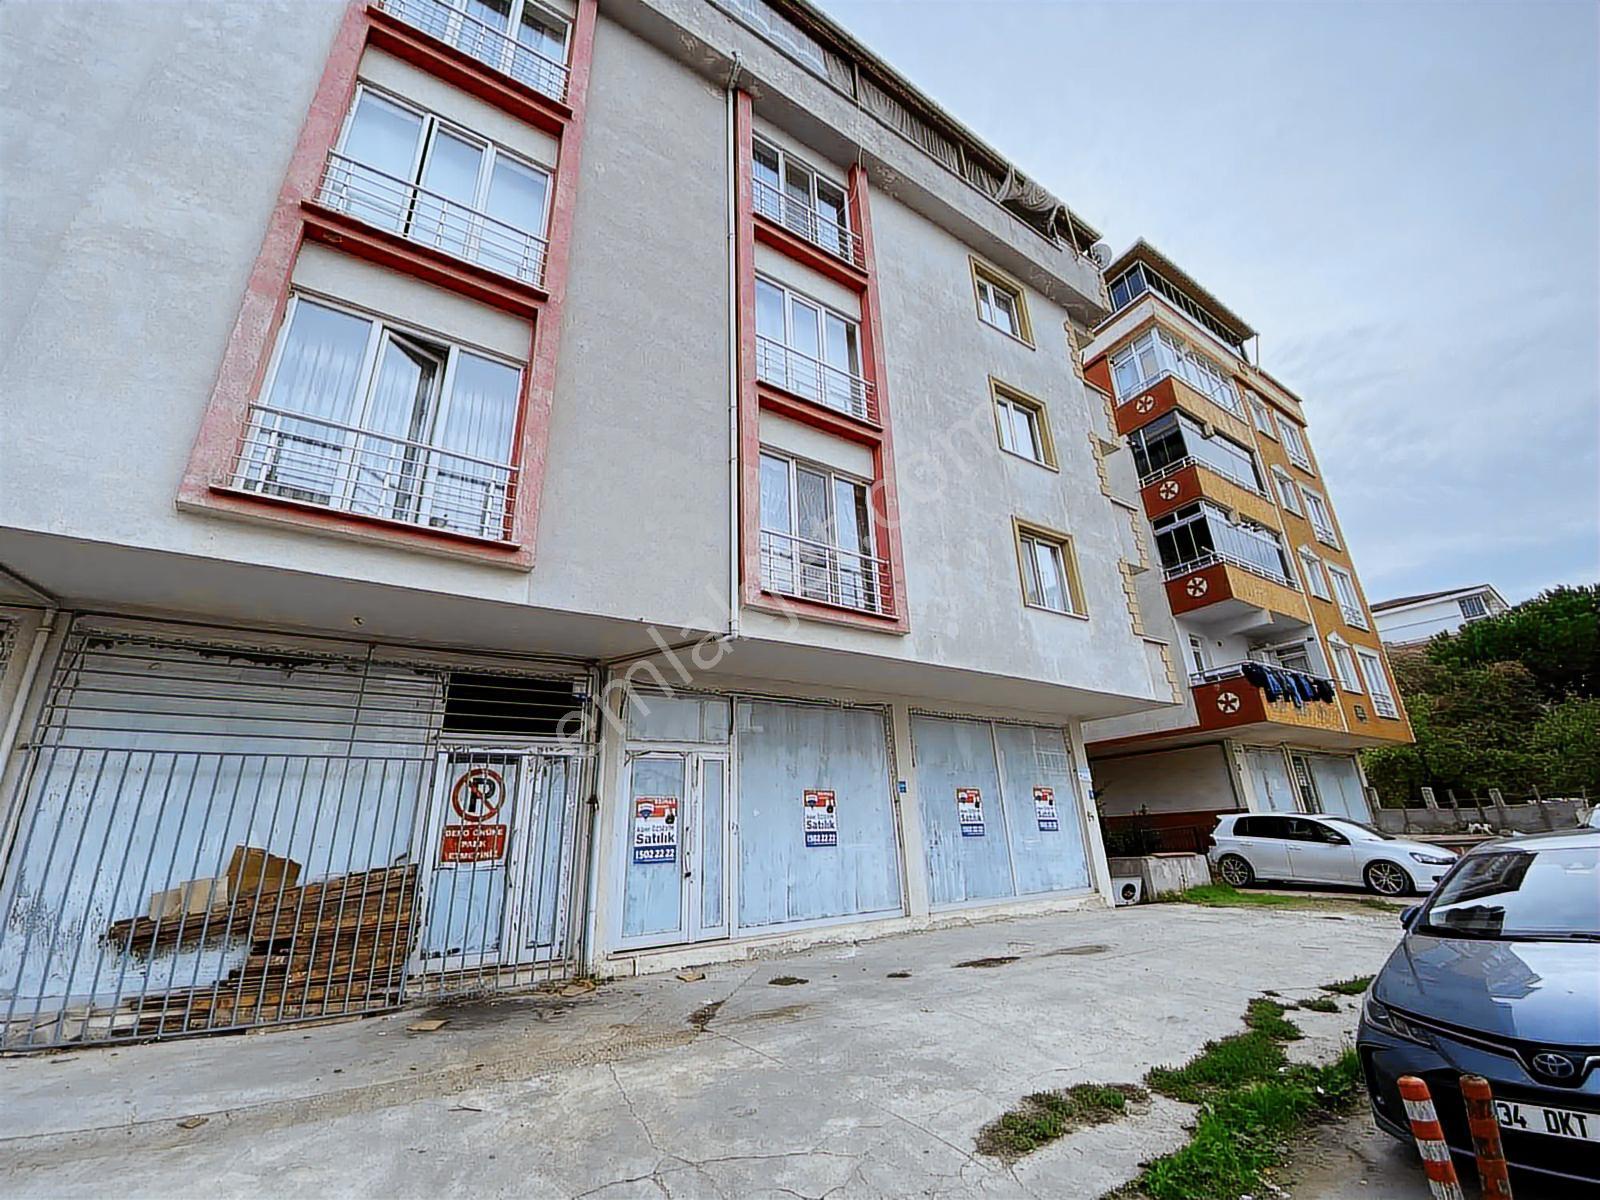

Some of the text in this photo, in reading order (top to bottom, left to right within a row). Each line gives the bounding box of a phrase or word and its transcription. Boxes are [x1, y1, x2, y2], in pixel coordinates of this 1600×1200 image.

[636, 832, 675, 844] Satılık
[1496, 1102, 1588, 1138] 34 DKT
